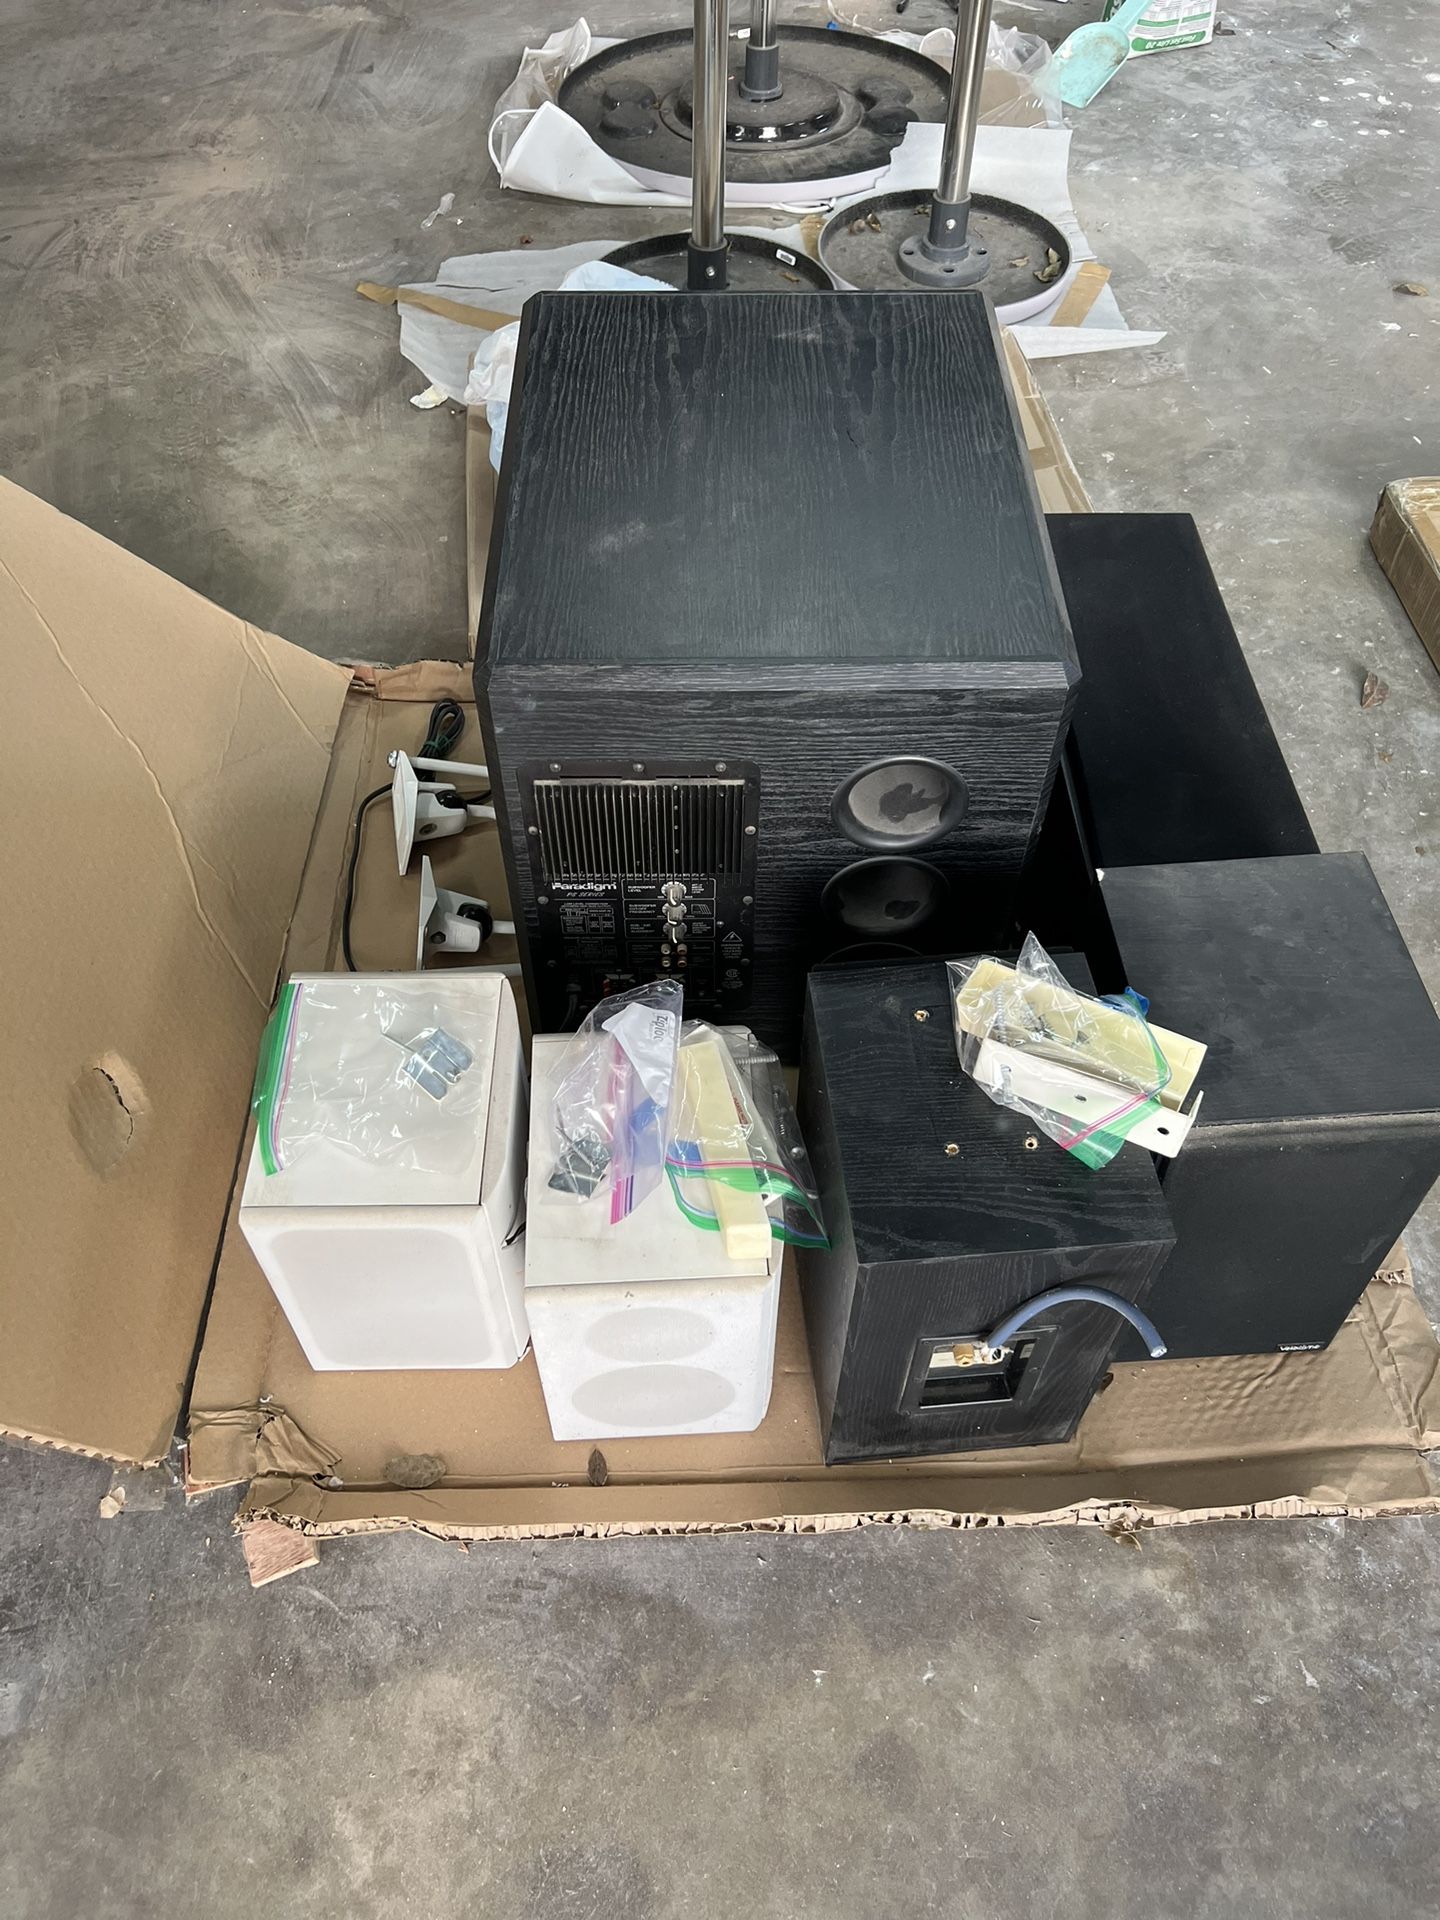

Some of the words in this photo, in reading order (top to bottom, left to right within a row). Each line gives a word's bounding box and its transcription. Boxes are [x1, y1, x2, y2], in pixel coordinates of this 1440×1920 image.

[1145, 41, 1157, 49] 20
[551, 882, 617, 892] Paradigm
[652, 1015, 669, 1042] Ziploc
